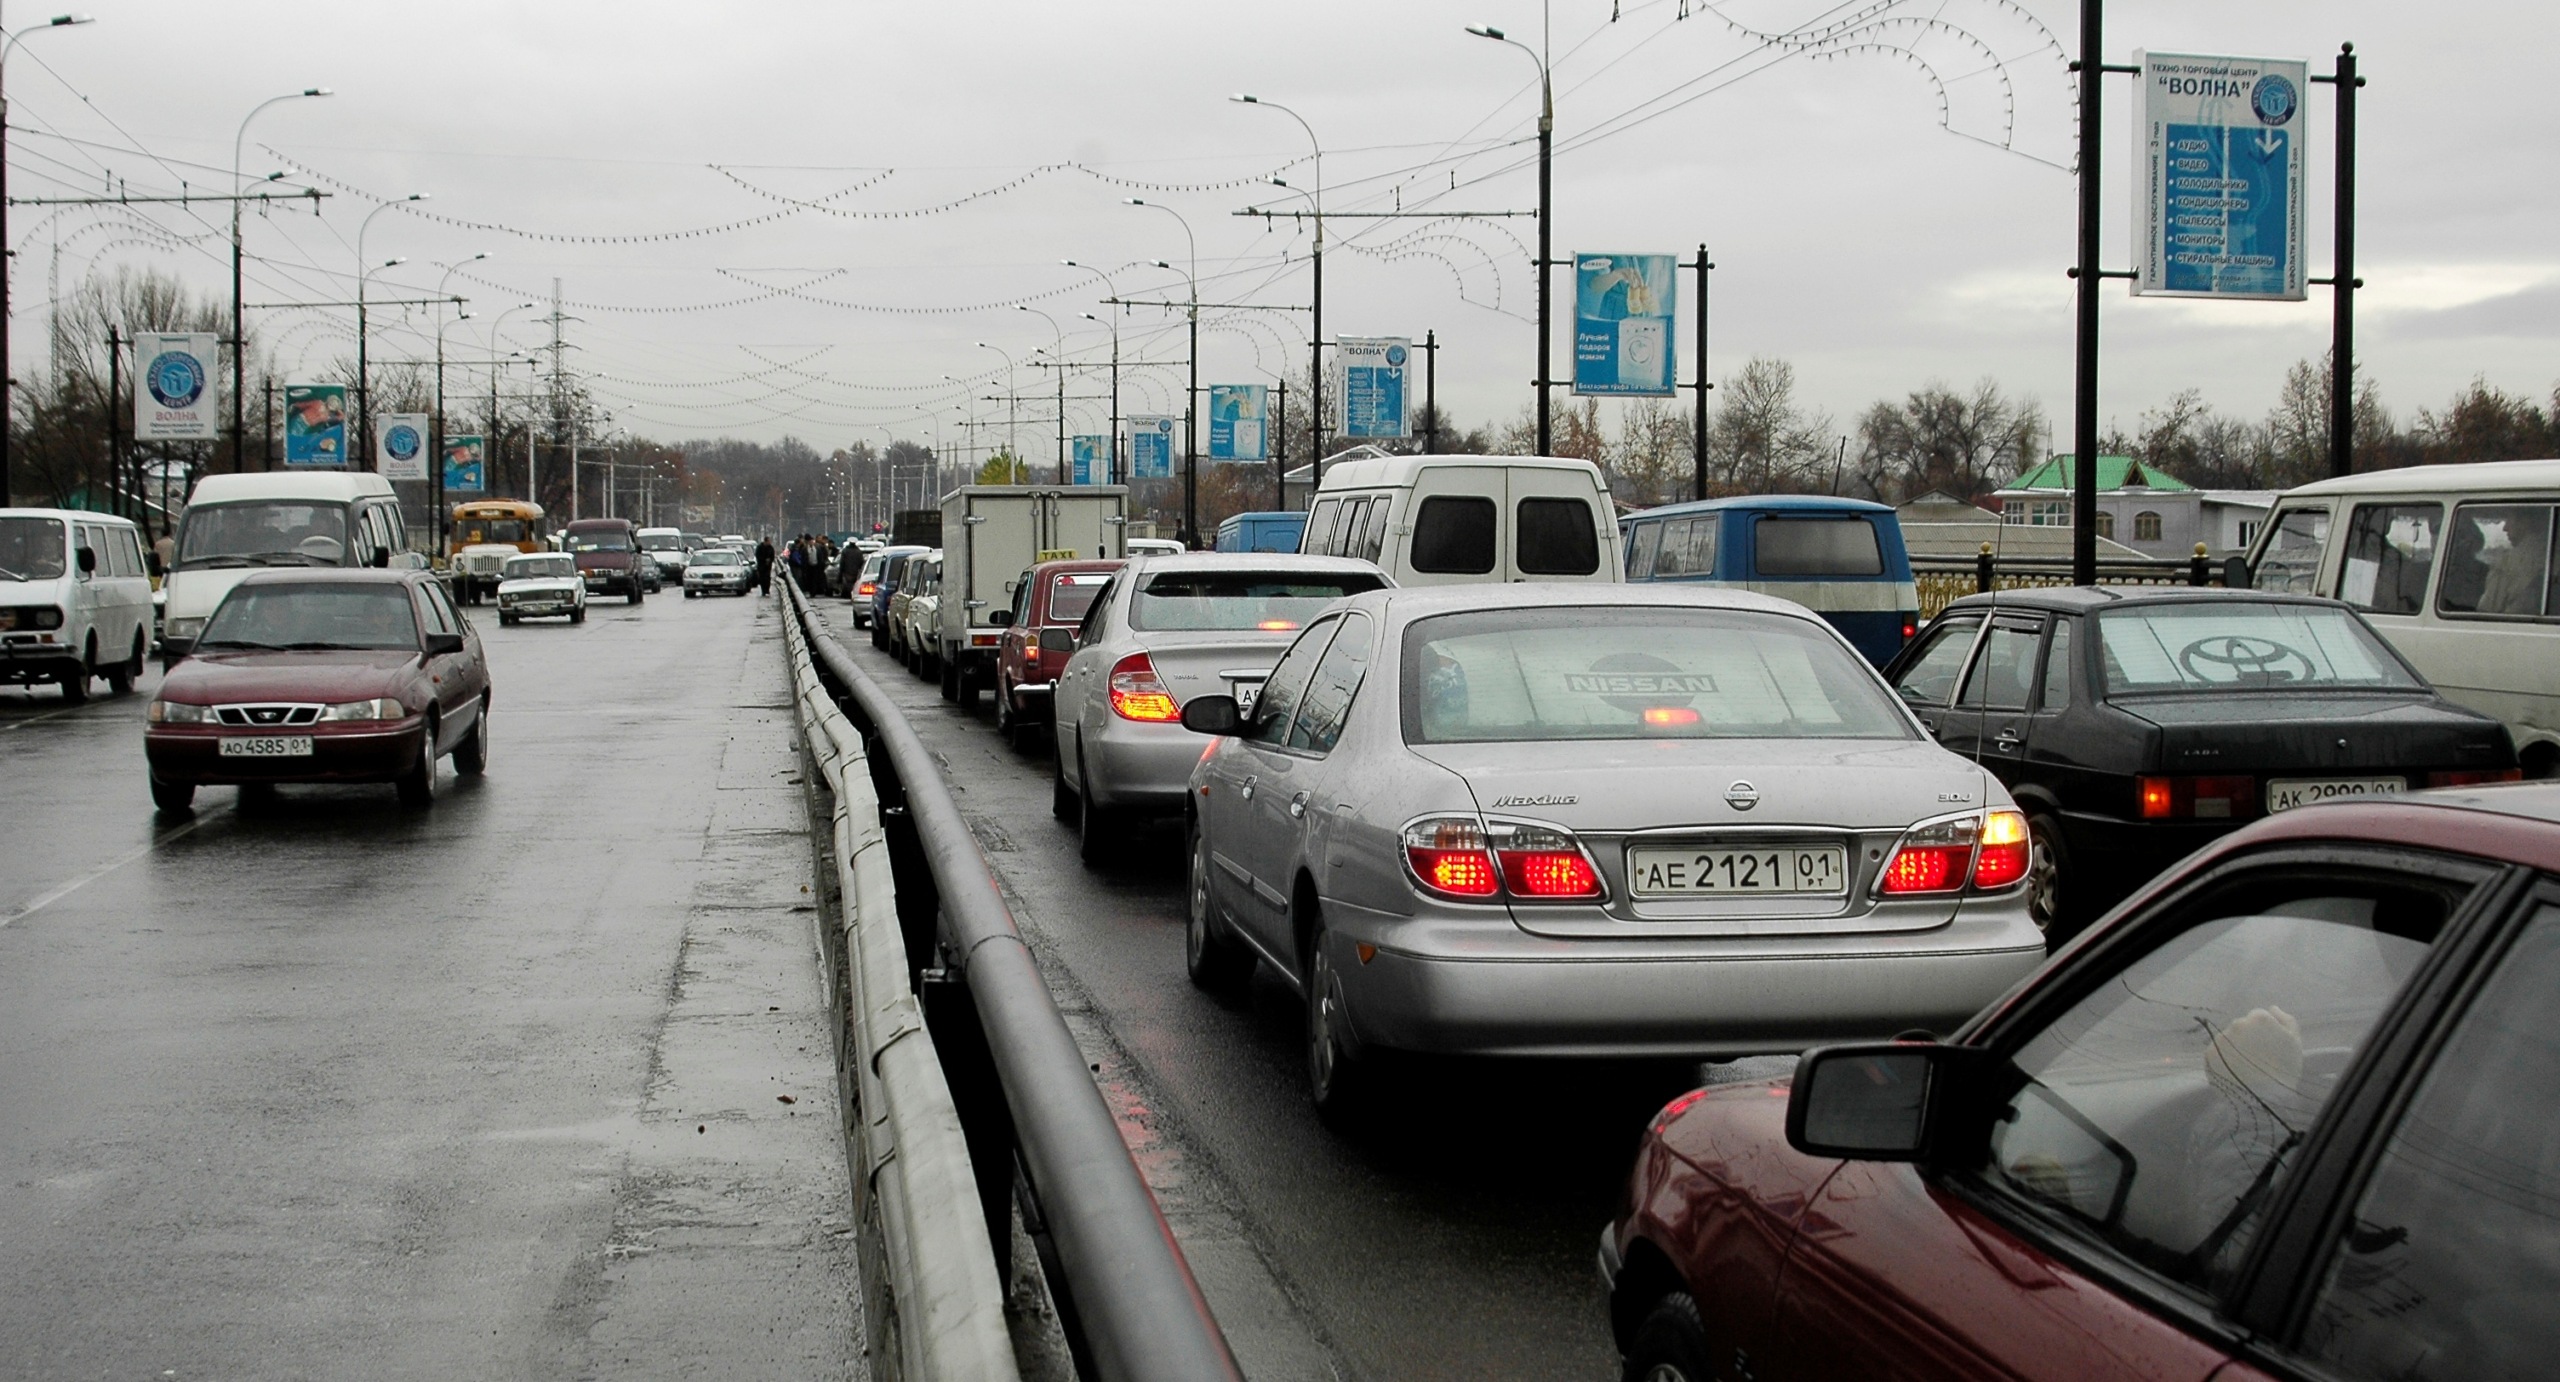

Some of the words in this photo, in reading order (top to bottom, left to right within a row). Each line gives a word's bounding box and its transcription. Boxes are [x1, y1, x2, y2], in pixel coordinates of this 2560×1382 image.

[2230, 68, 2258, 77] ЦЕНТР
[2158, 76, 2250, 98] “ВОЛНА”
[2178, 140, 2208, 151] АУДИО
[2178, 159, 2208, 170] ВИДЕО
[2178, 179, 2248, 190] ХОЛОДИЛЬНИКИ
[2177, 197, 2249, 210] КОНДИЦИОНЕРЫ
[2177, 216, 2226, 227] ПЫЛЕСОСЫ
[2177, 235, 2226, 246] МОНИТОРЫ
[2176, 253, 2232, 264] СТИРАЛЬНЫЕ
[2234, 256, 2274, 266] МАШИНЫ
[155, 411, 198, 421] ВОЛНА
[1042, 551, 1073, 560] TAXI
[1570, 676, 1714, 692] NISSAN
[224, 742, 243, 754] АО
[245, 739, 285, 754] 4585
[291, 738, 307, 750] 01
[1491, 794, 1580, 808] Maxima
[2279, 790, 2303, 809] АК
[1647, 862, 1686, 889] АЕ
[1694, 853, 1780, 888] 2121
[1798, 853, 1830, 877] 01
